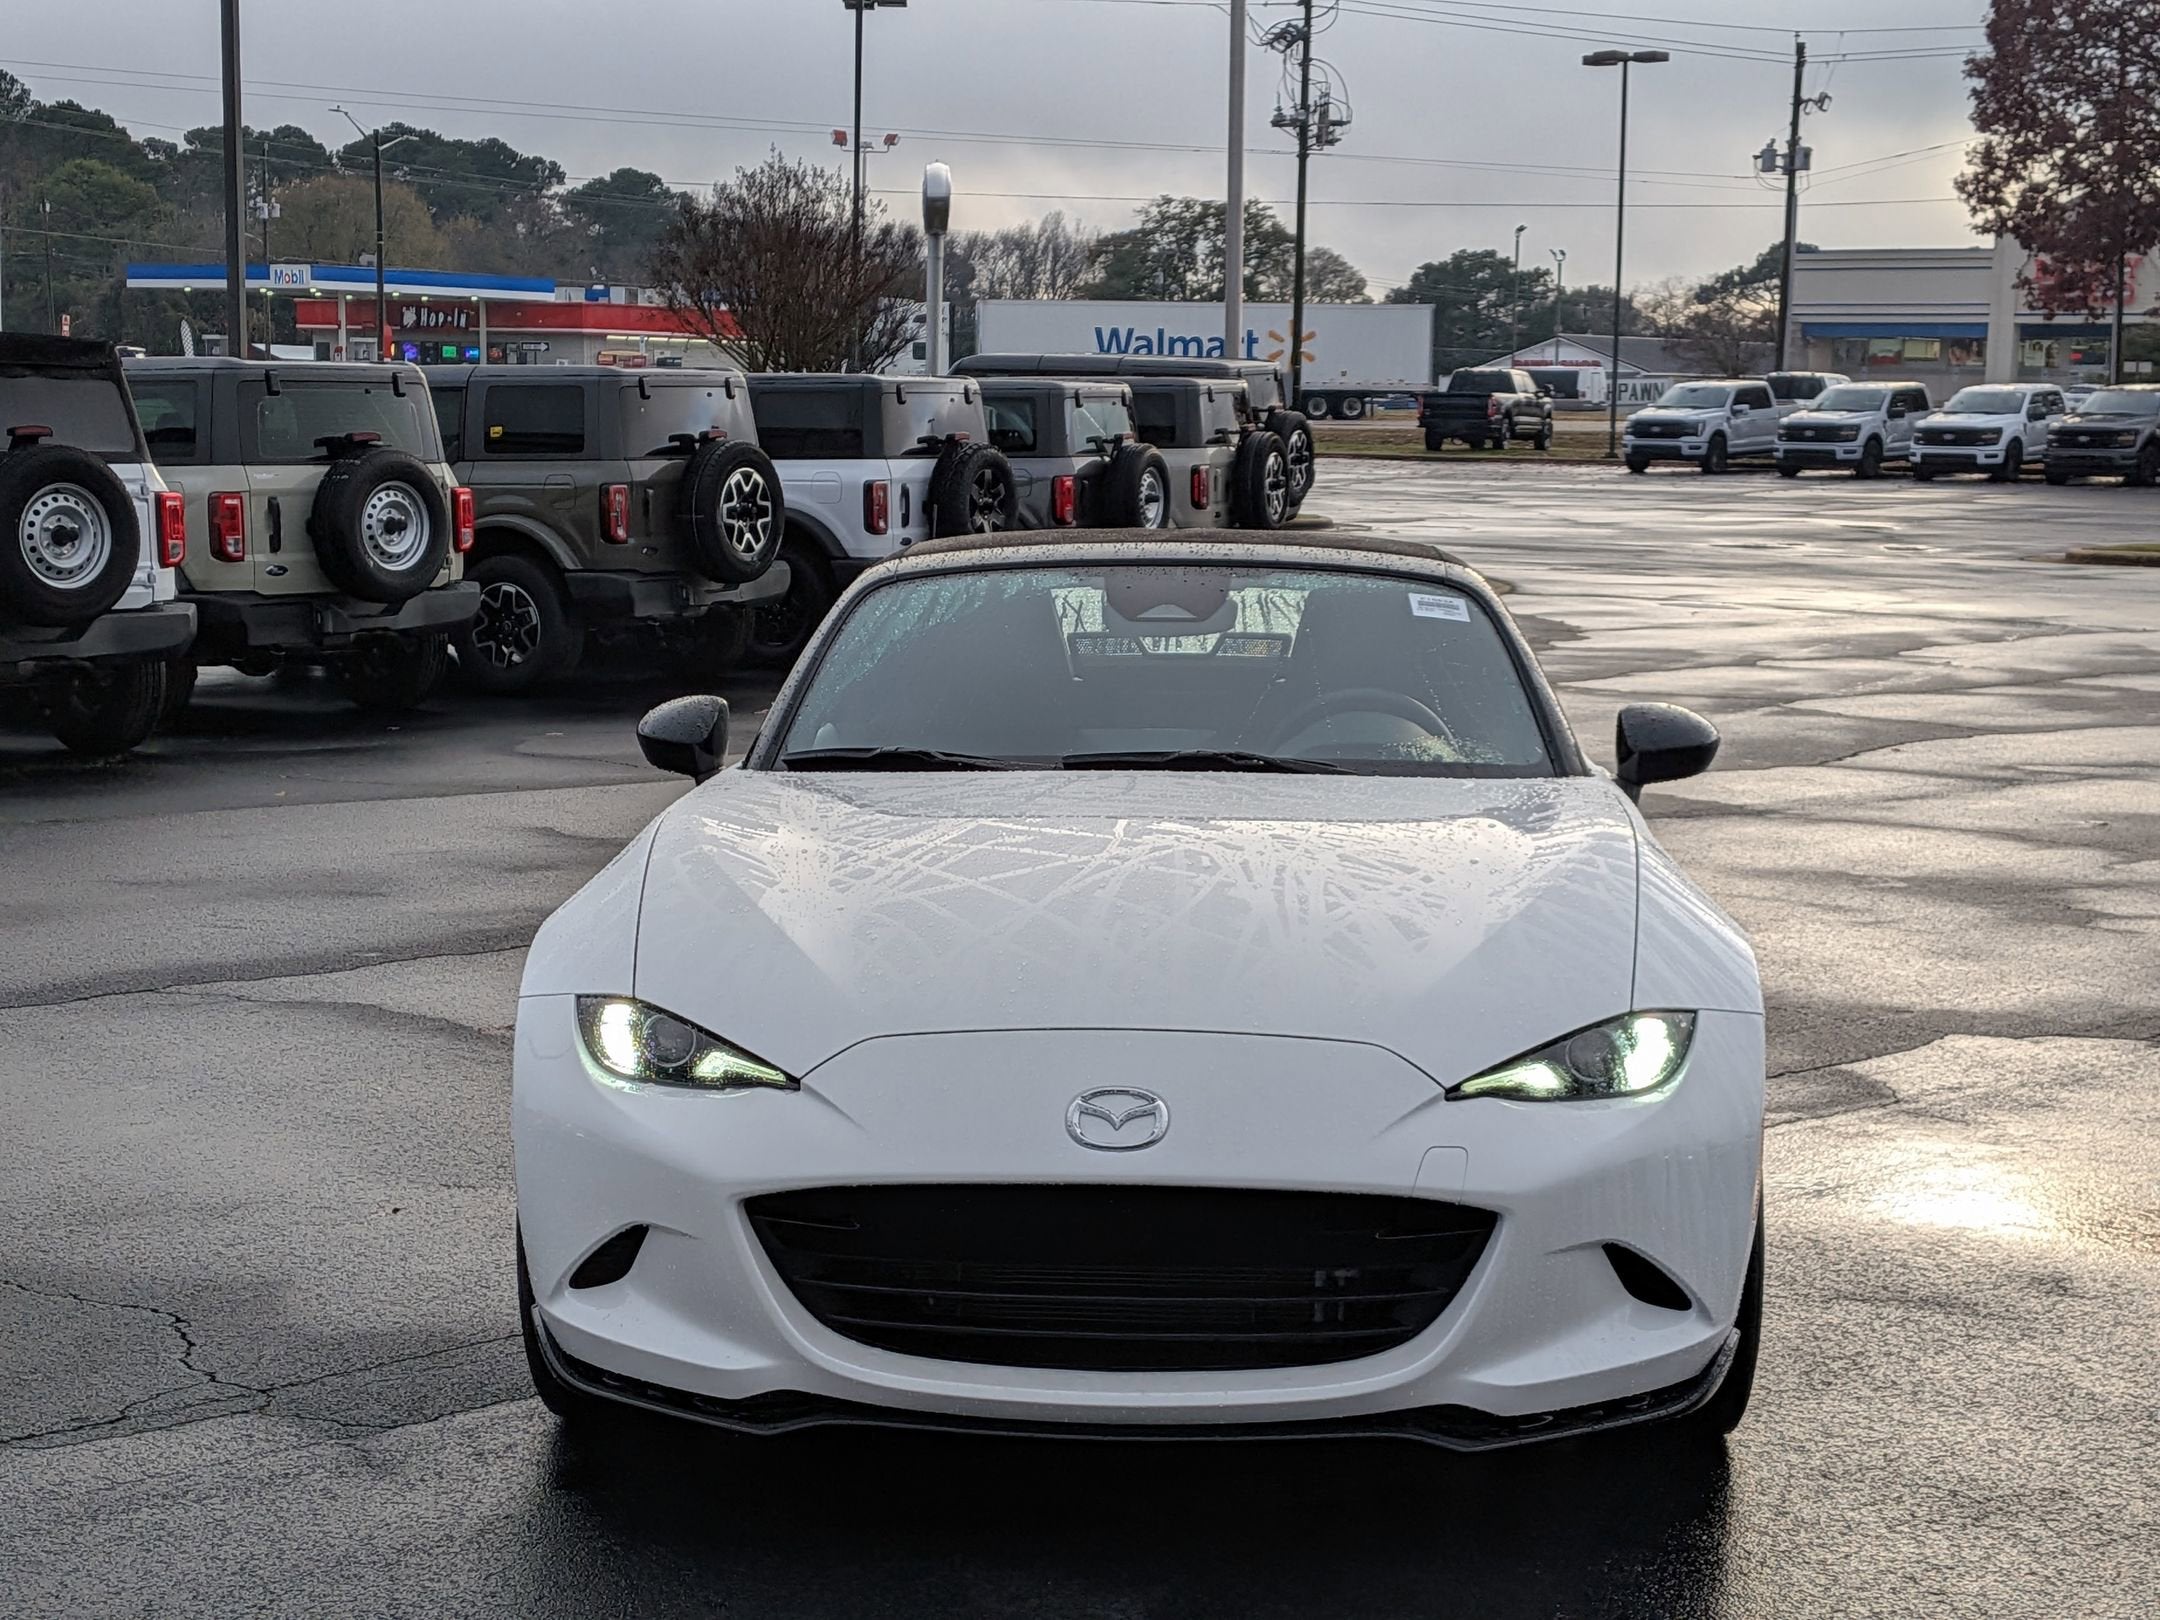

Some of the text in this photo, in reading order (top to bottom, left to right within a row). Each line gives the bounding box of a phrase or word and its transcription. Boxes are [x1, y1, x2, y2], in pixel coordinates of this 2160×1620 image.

[274, 269, 305, 285] Mobil
[1095, 327, 1259, 359] Walmat
[1618, 382, 1665, 401] PAWN
